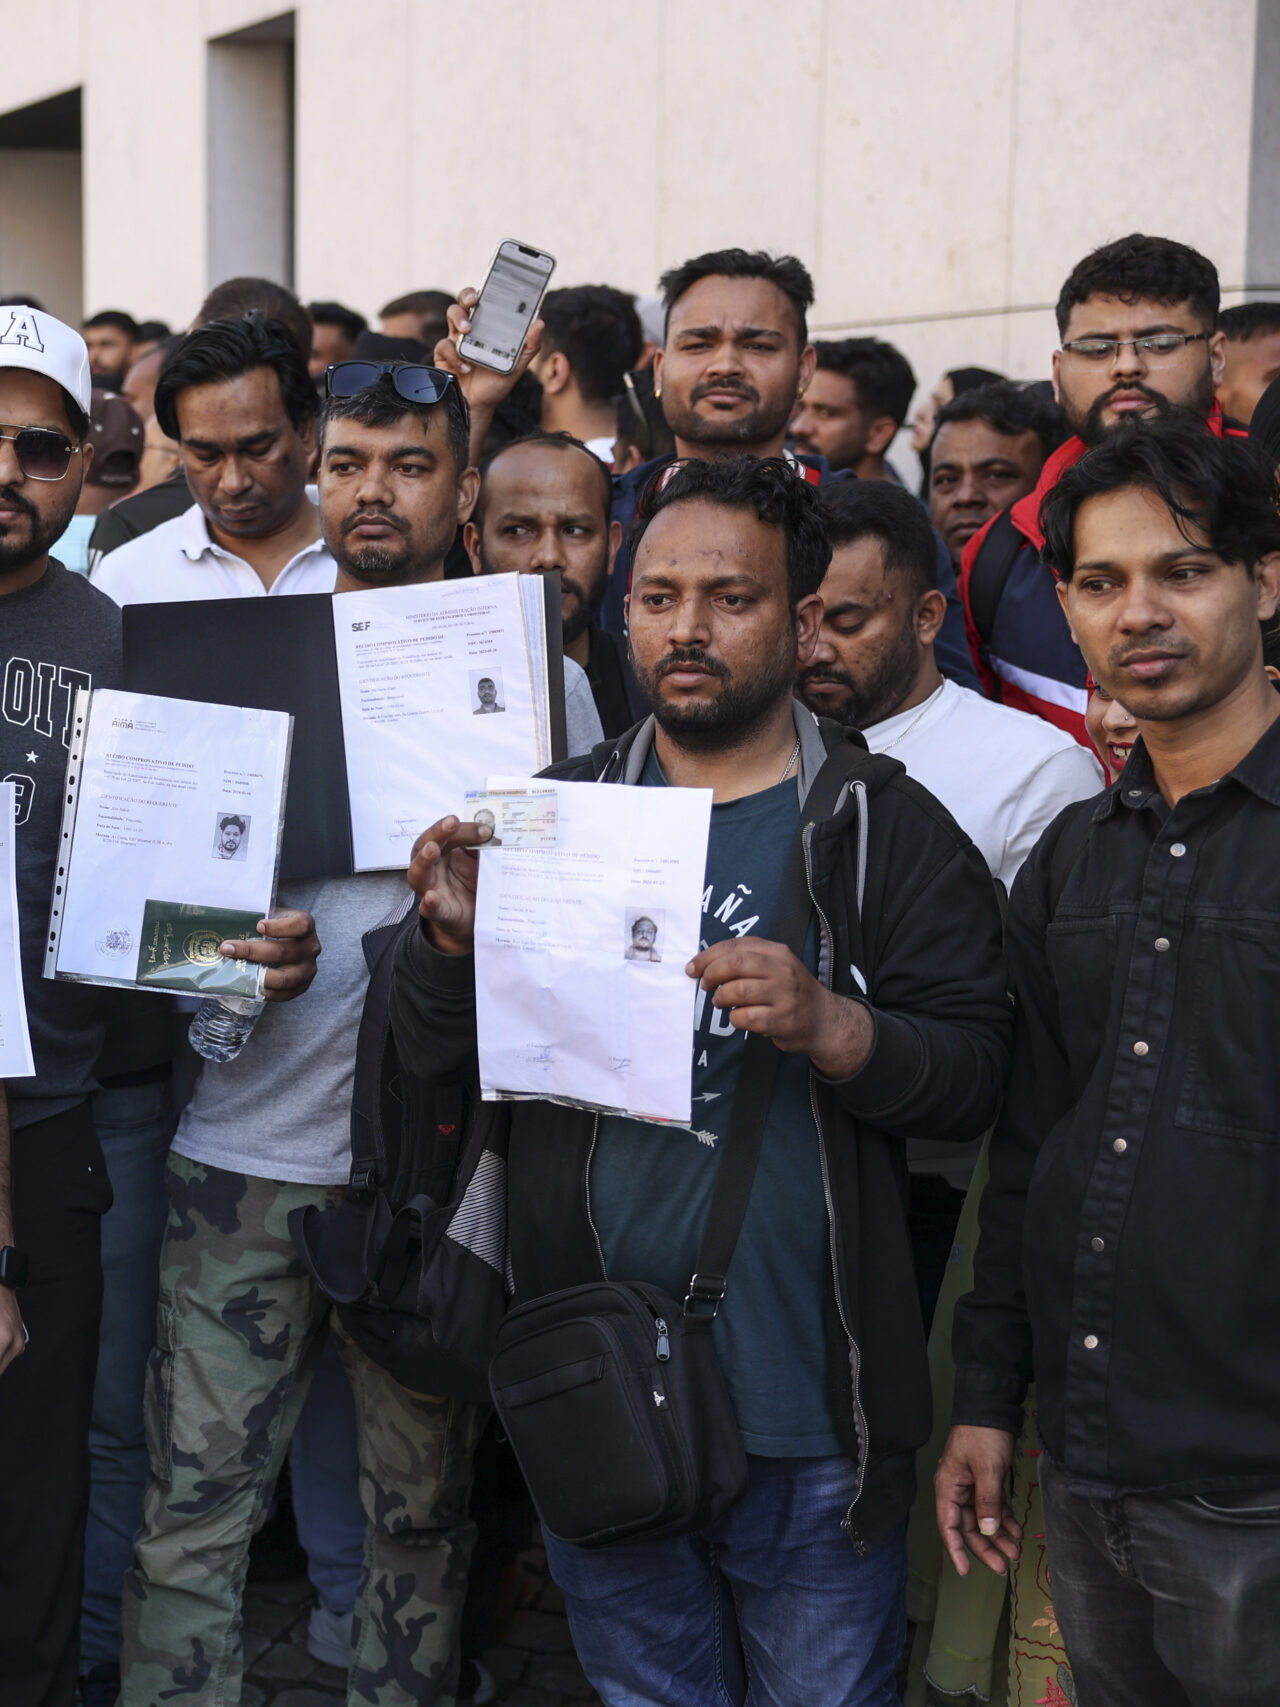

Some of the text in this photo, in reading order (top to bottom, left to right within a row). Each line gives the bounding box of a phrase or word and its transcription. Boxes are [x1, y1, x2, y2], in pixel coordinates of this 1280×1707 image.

[0, 311, 44, 353] A
[352, 621, 371, 632] SEF
[112, 720, 134, 730] AIMA
